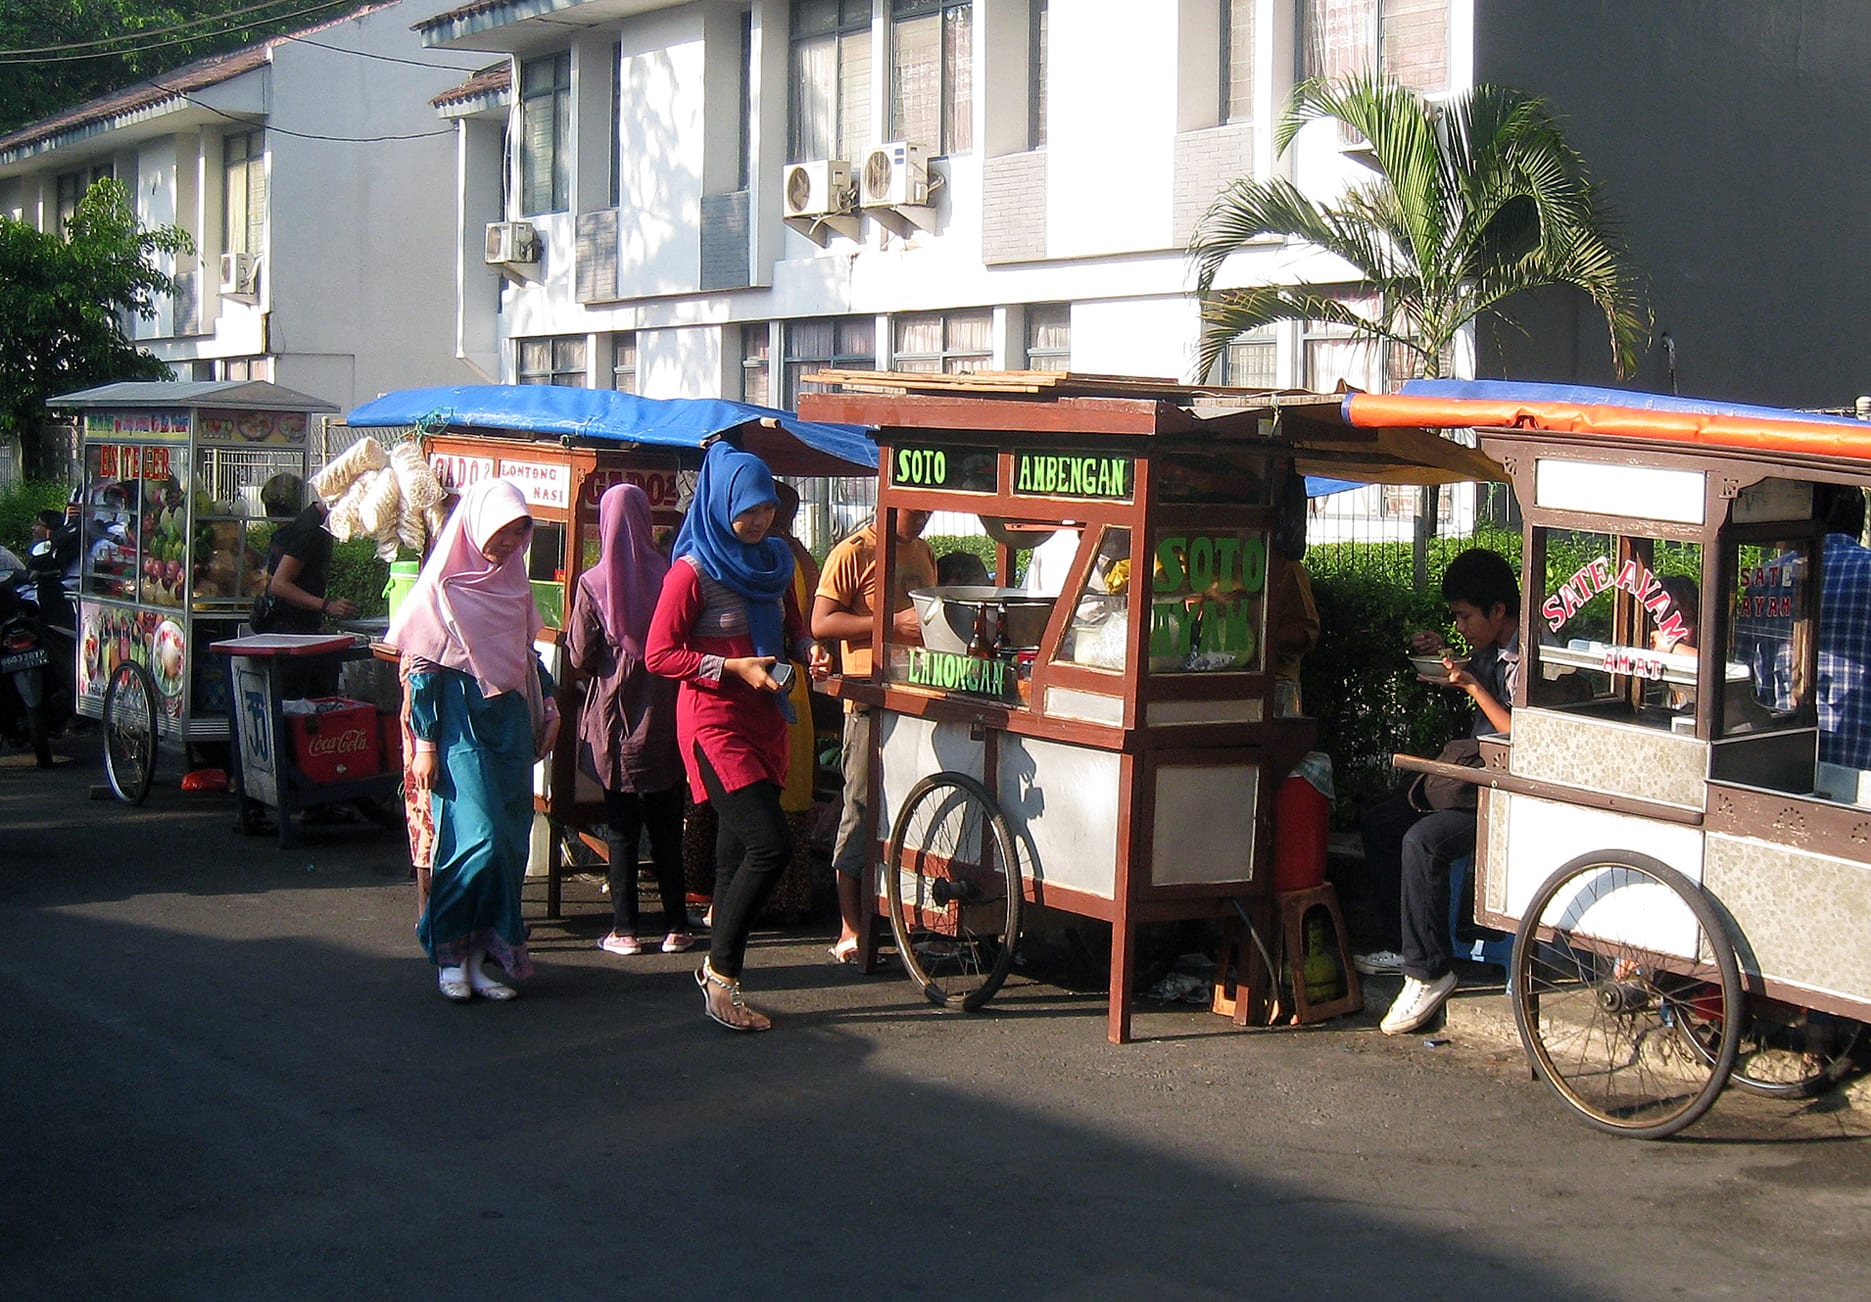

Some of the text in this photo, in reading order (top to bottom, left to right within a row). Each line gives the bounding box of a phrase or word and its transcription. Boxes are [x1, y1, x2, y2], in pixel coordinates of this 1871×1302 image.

[101, 445, 118, 478] ES
[501, 464, 557, 481] LONTONG
[896, 448, 1126, 497] SOTO AMBENGAN
[533, 487, 563, 502] NASI
[1153, 537, 1265, 592] SOTO
[1740, 566, 1793, 588] SATE
[1541, 556, 1689, 646] SATE AYAM
[1740, 596, 1792, 617] AYAM
[1150, 599, 1249, 656] AYAM
[908, 650, 1005, 696] LAMONGAN
[1602, 652, 1664, 680] AMAT
